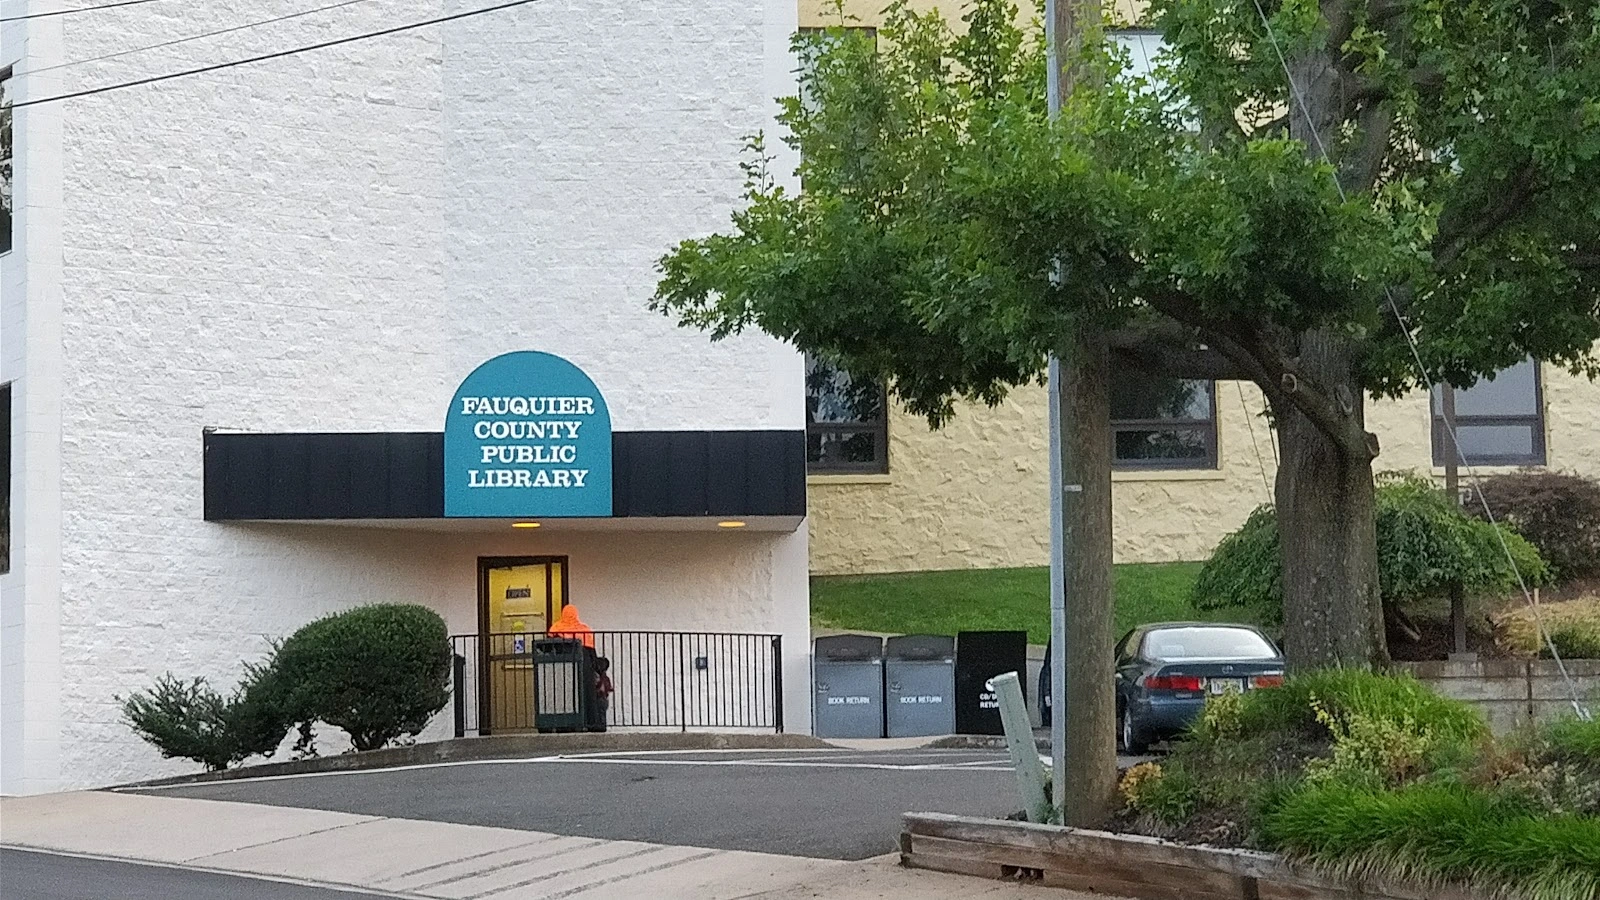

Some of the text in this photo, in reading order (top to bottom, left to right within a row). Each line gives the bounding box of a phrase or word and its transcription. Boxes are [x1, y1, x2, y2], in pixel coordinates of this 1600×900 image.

[461, 396, 595, 416] FAUQUIER
[474, 421, 582, 439] COUNTY
[480, 445, 576, 463] PUBLIC
[468, 469, 588, 488] LIBRARY
[508, 589, 530, 598] OPEN
[828, 696, 870, 705] BOOK RETURN
[900, 695, 942, 704] BOOK RETURN
